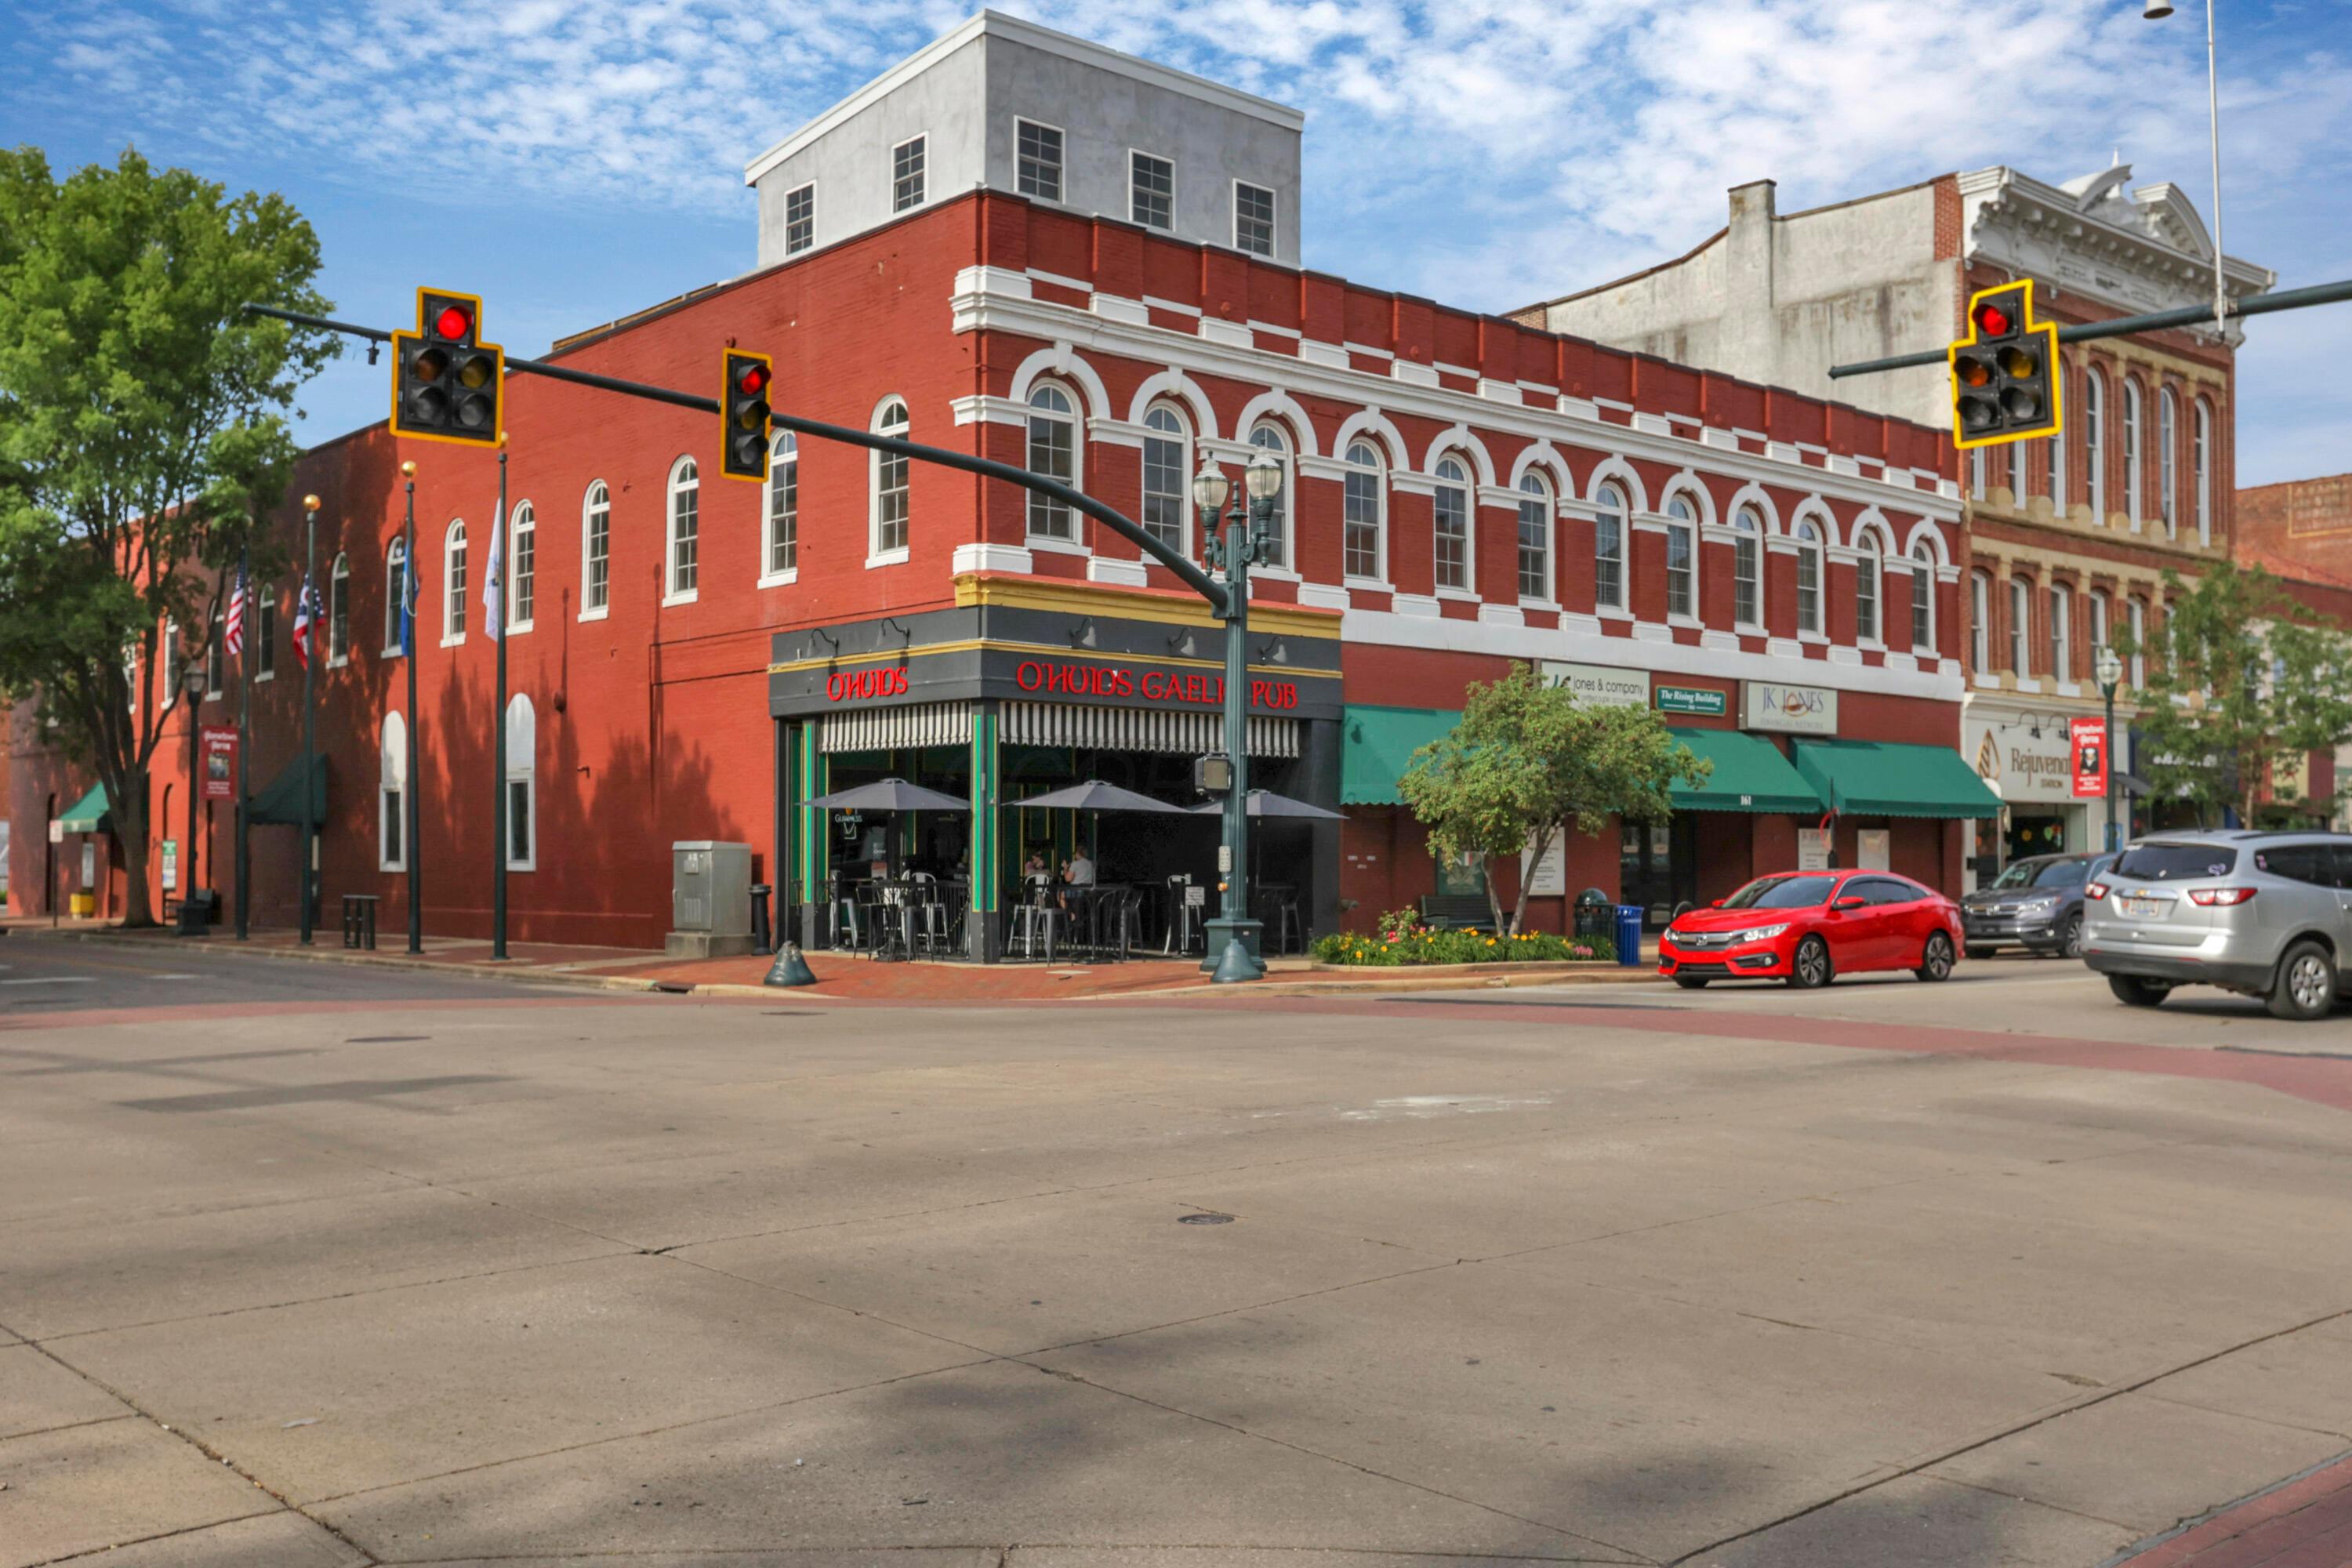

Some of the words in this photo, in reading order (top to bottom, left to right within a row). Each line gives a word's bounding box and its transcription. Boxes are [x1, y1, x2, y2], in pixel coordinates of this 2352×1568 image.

[1142, 671, 1226, 703] GAELI
[1251, 680, 1298, 710] PUB
[1573, 676, 1595, 691] jones
[1596, 678, 1603, 691] &
[1661, 689, 1673, 700] The
[1673, 691, 1694, 704] Rising
[1694, 692, 1722, 706] Building
[1740, 795, 1751, 805] 161
